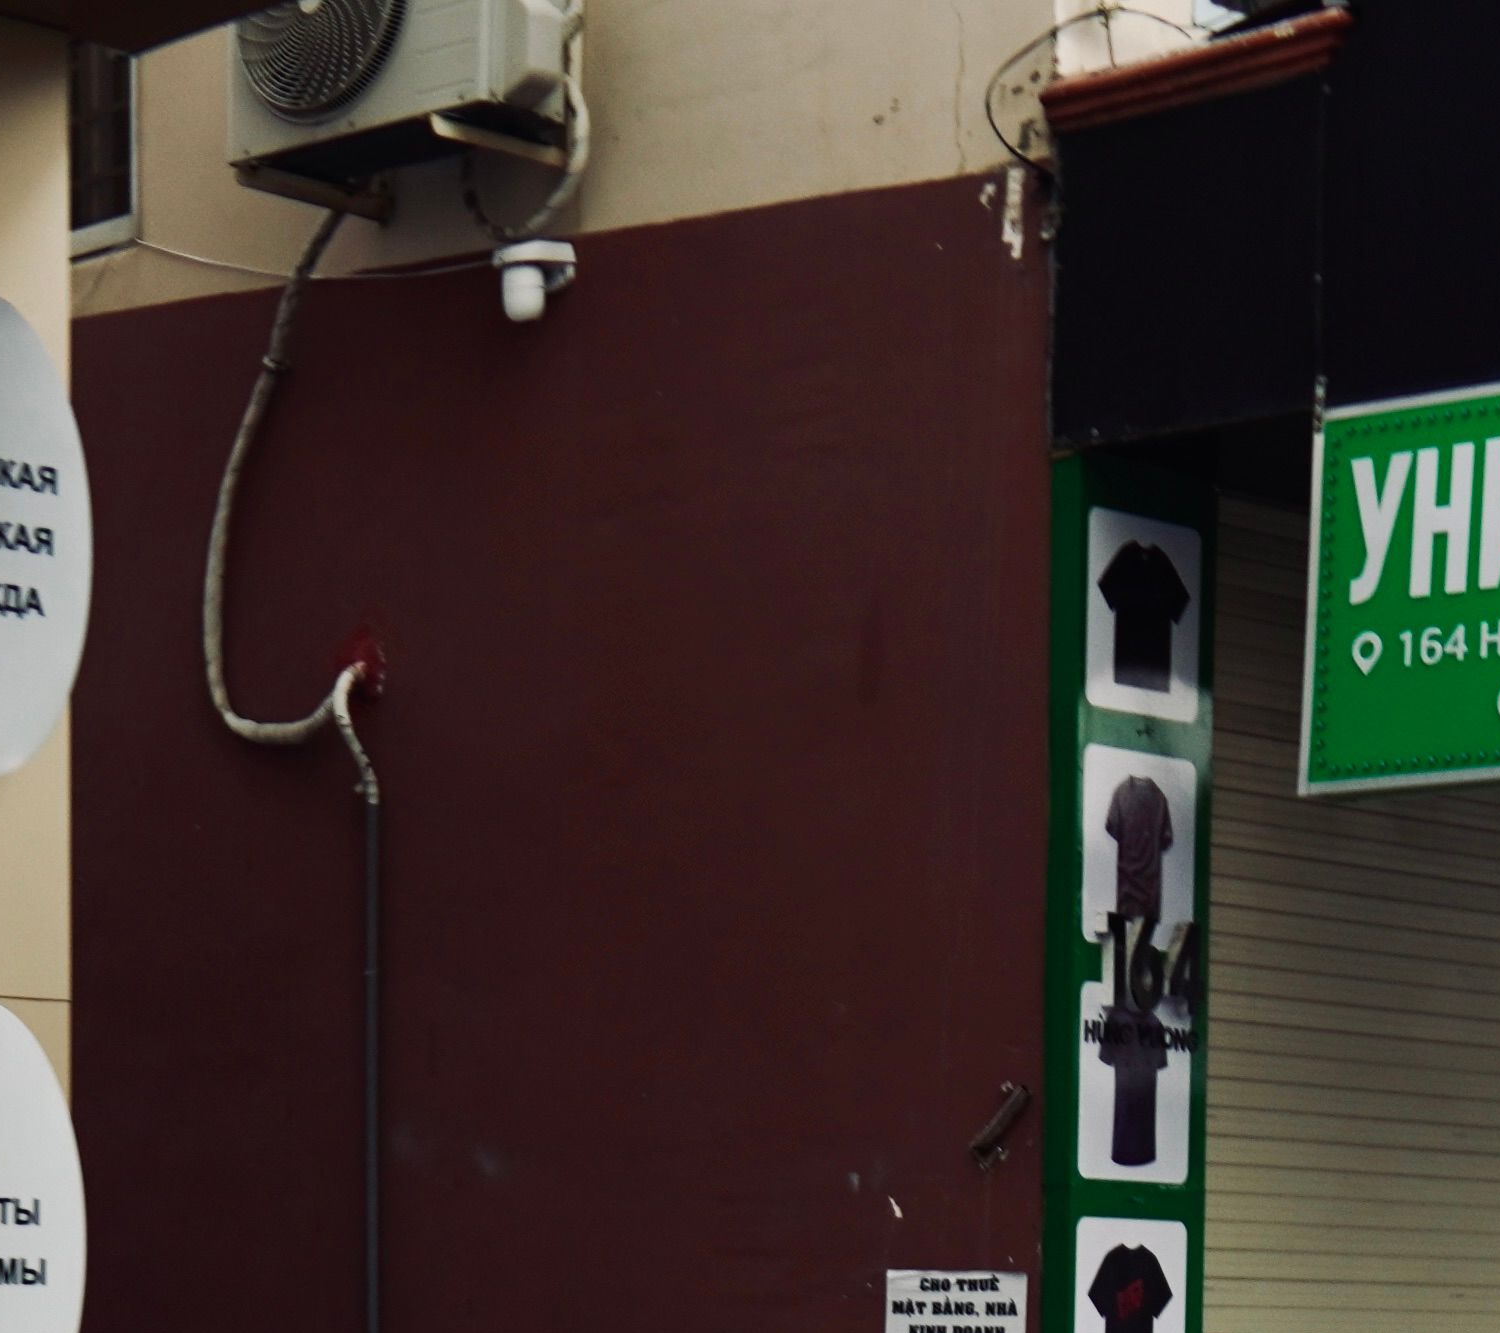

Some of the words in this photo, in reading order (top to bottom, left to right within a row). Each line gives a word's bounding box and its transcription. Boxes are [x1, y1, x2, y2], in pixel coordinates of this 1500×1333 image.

[1398, 625, 1469, 668] 164
[1095, 911, 1199, 1015] 164
[919, 1277, 951, 1292] CHO
[985, 1298, 1018, 1317] NHÀ
